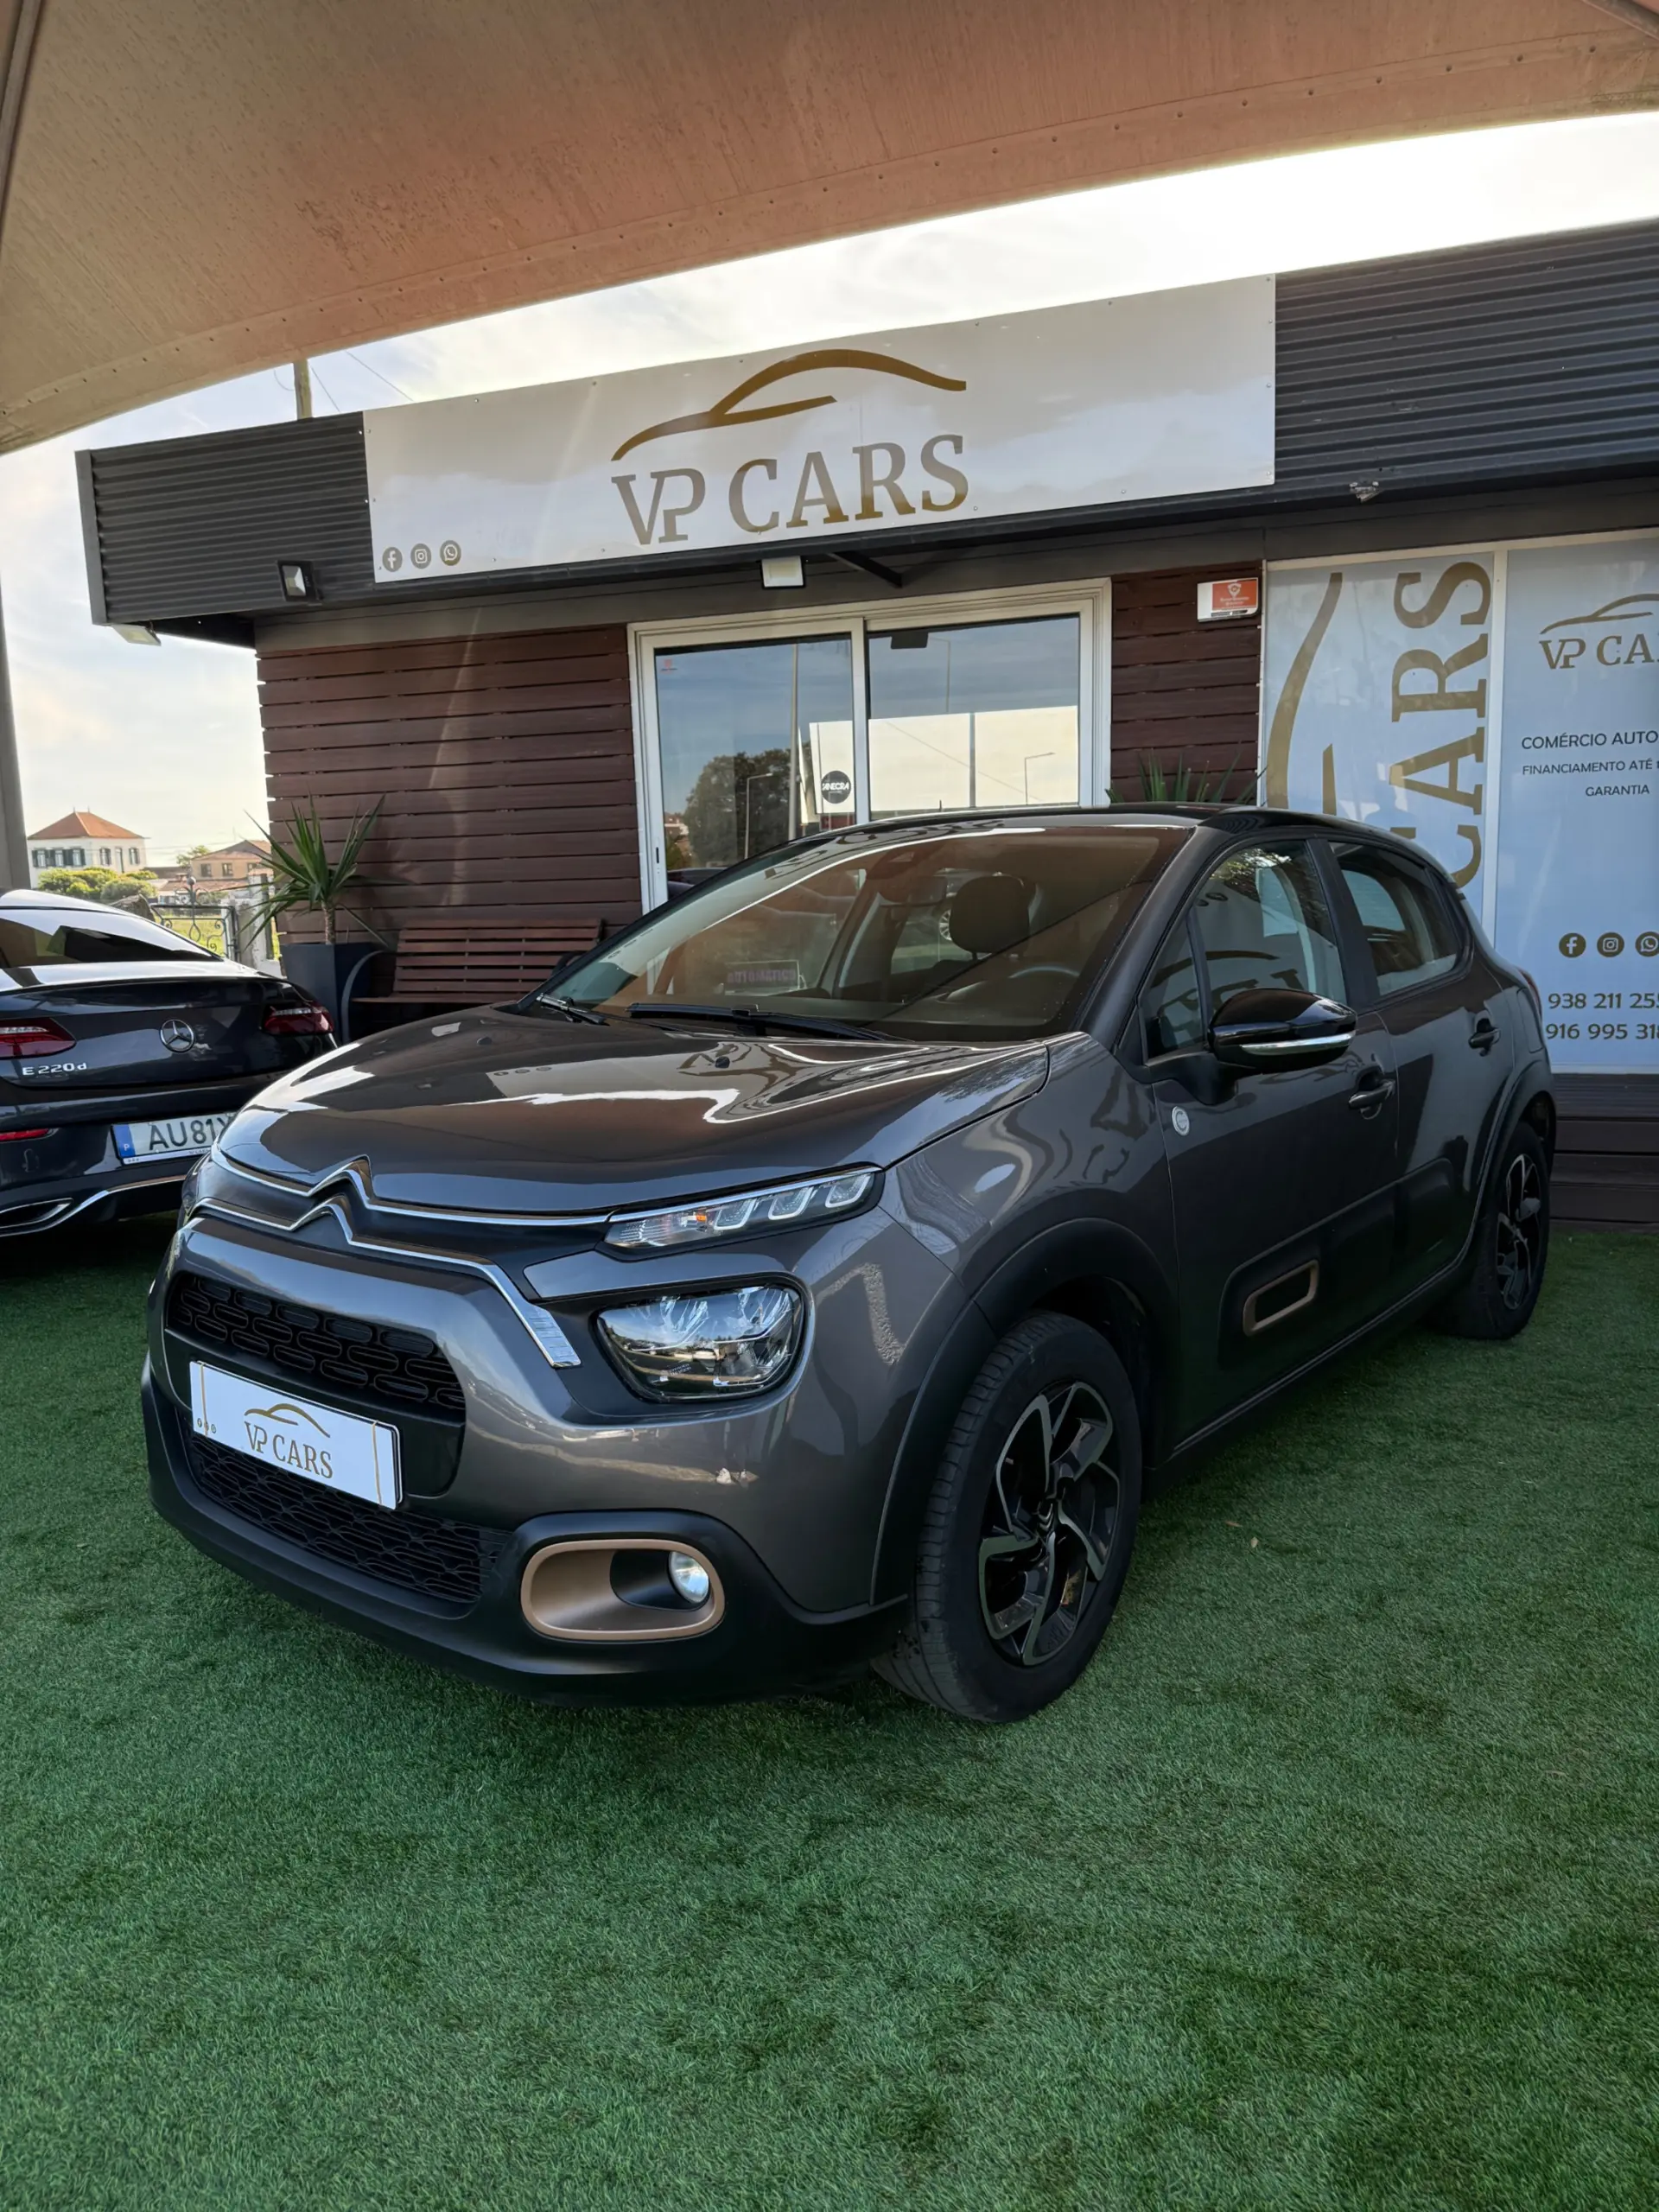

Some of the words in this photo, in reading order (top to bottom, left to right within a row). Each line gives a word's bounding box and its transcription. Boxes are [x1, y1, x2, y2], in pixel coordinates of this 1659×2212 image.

[612, 467, 706, 545] VP
[728, 434, 969, 534] CARS
[1538, 638, 1586, 670] VP
[1596, 632, 1659, 666] CA
[1521, 733, 1607, 749] COMÉRCIO
[1522, 760, 1625, 775] FINANCIAMENTO
[1629, 758, 1653, 770] ATÉ
[1585, 785, 1649, 797] GARANTIA
[1548, 993, 1587, 1009] 938
[1593, 993, 1622, 1009] 211
[1545, 1023, 1580, 1039] 916
[1587, 1023, 1628, 1039] 995
[1635, 1023, 1659, 1039] 31
[22, 1066, 35, 1076] E
[244, 1421, 268, 1454] VP
[272, 1434, 334, 1479] CARS
